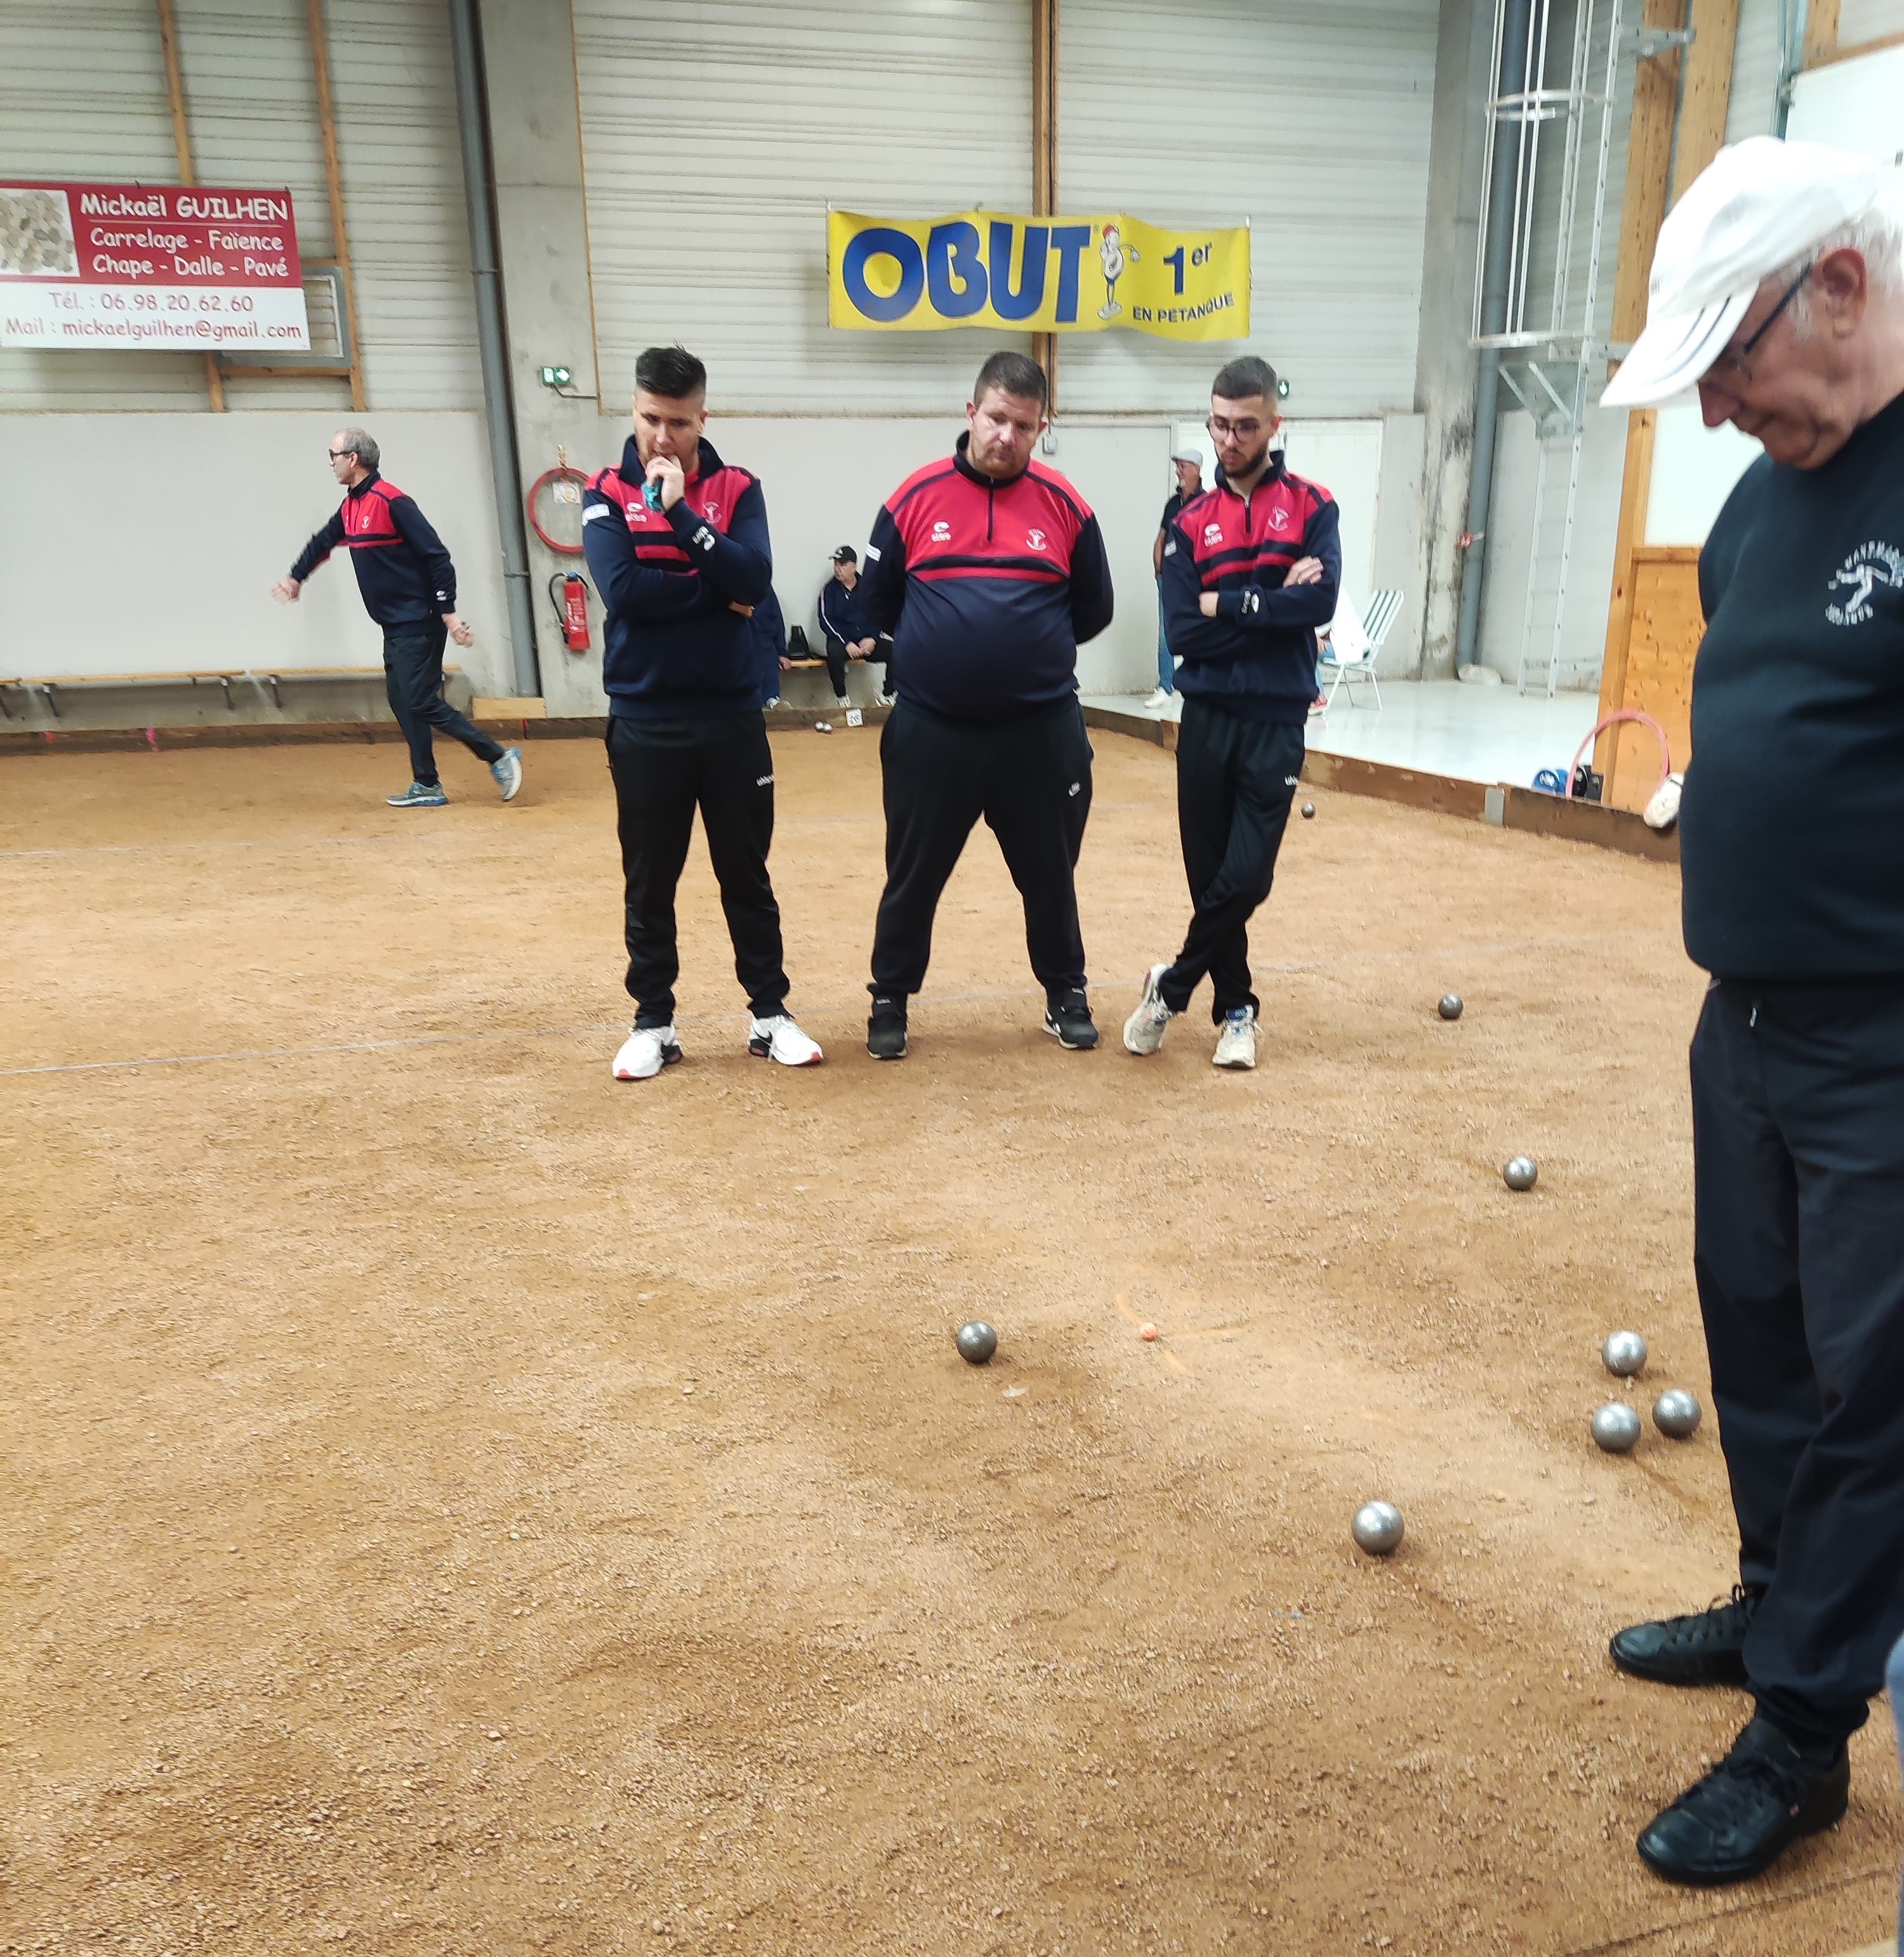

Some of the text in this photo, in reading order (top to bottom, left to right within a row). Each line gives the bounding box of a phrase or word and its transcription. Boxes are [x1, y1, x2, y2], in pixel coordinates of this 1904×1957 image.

[80, 192, 289, 221] Mickaël GUILHEN
[90, 227, 190, 254] Carrelage
[208, 228, 285, 251] Faïence
[92, 253, 155, 279] Chape
[175, 256, 225, 277] Dalle
[244, 256, 290, 278] Pavé
[843, 221, 1091, 324] OBUT
[1163, 242, 1212, 295] 1er
[48, 291, 84, 311] Tél.
[100, 293, 254, 312] 06.98.20.62.60
[1132, 305, 1153, 323] EN
[5, 317, 45, 335] Mail
[62, 319, 303, 342] mickaelguilhen@gmail.com
